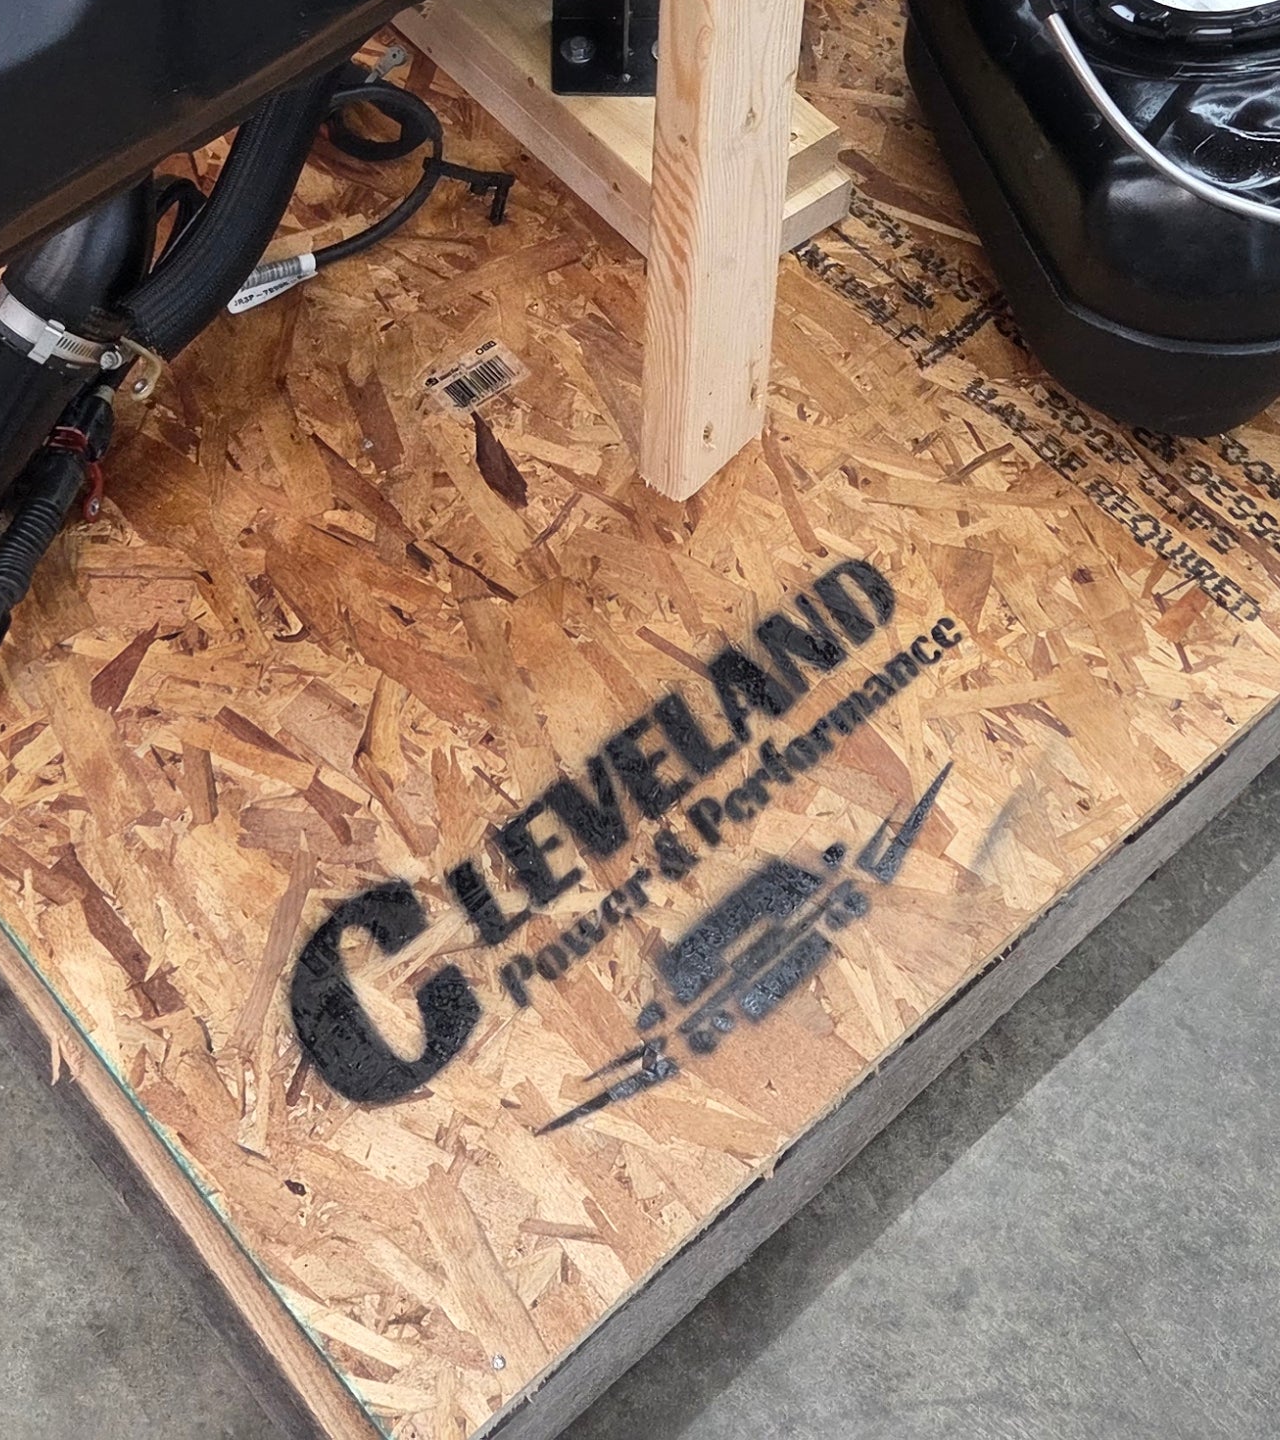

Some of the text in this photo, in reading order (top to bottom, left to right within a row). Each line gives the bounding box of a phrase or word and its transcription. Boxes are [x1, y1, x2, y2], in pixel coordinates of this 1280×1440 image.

[1084, 476, 1261, 621] REQUIRED
[290, 557, 898, 1107] CLEVELAND
[499, 867, 652, 1008] Power
[687, 617, 962, 847] Performance
